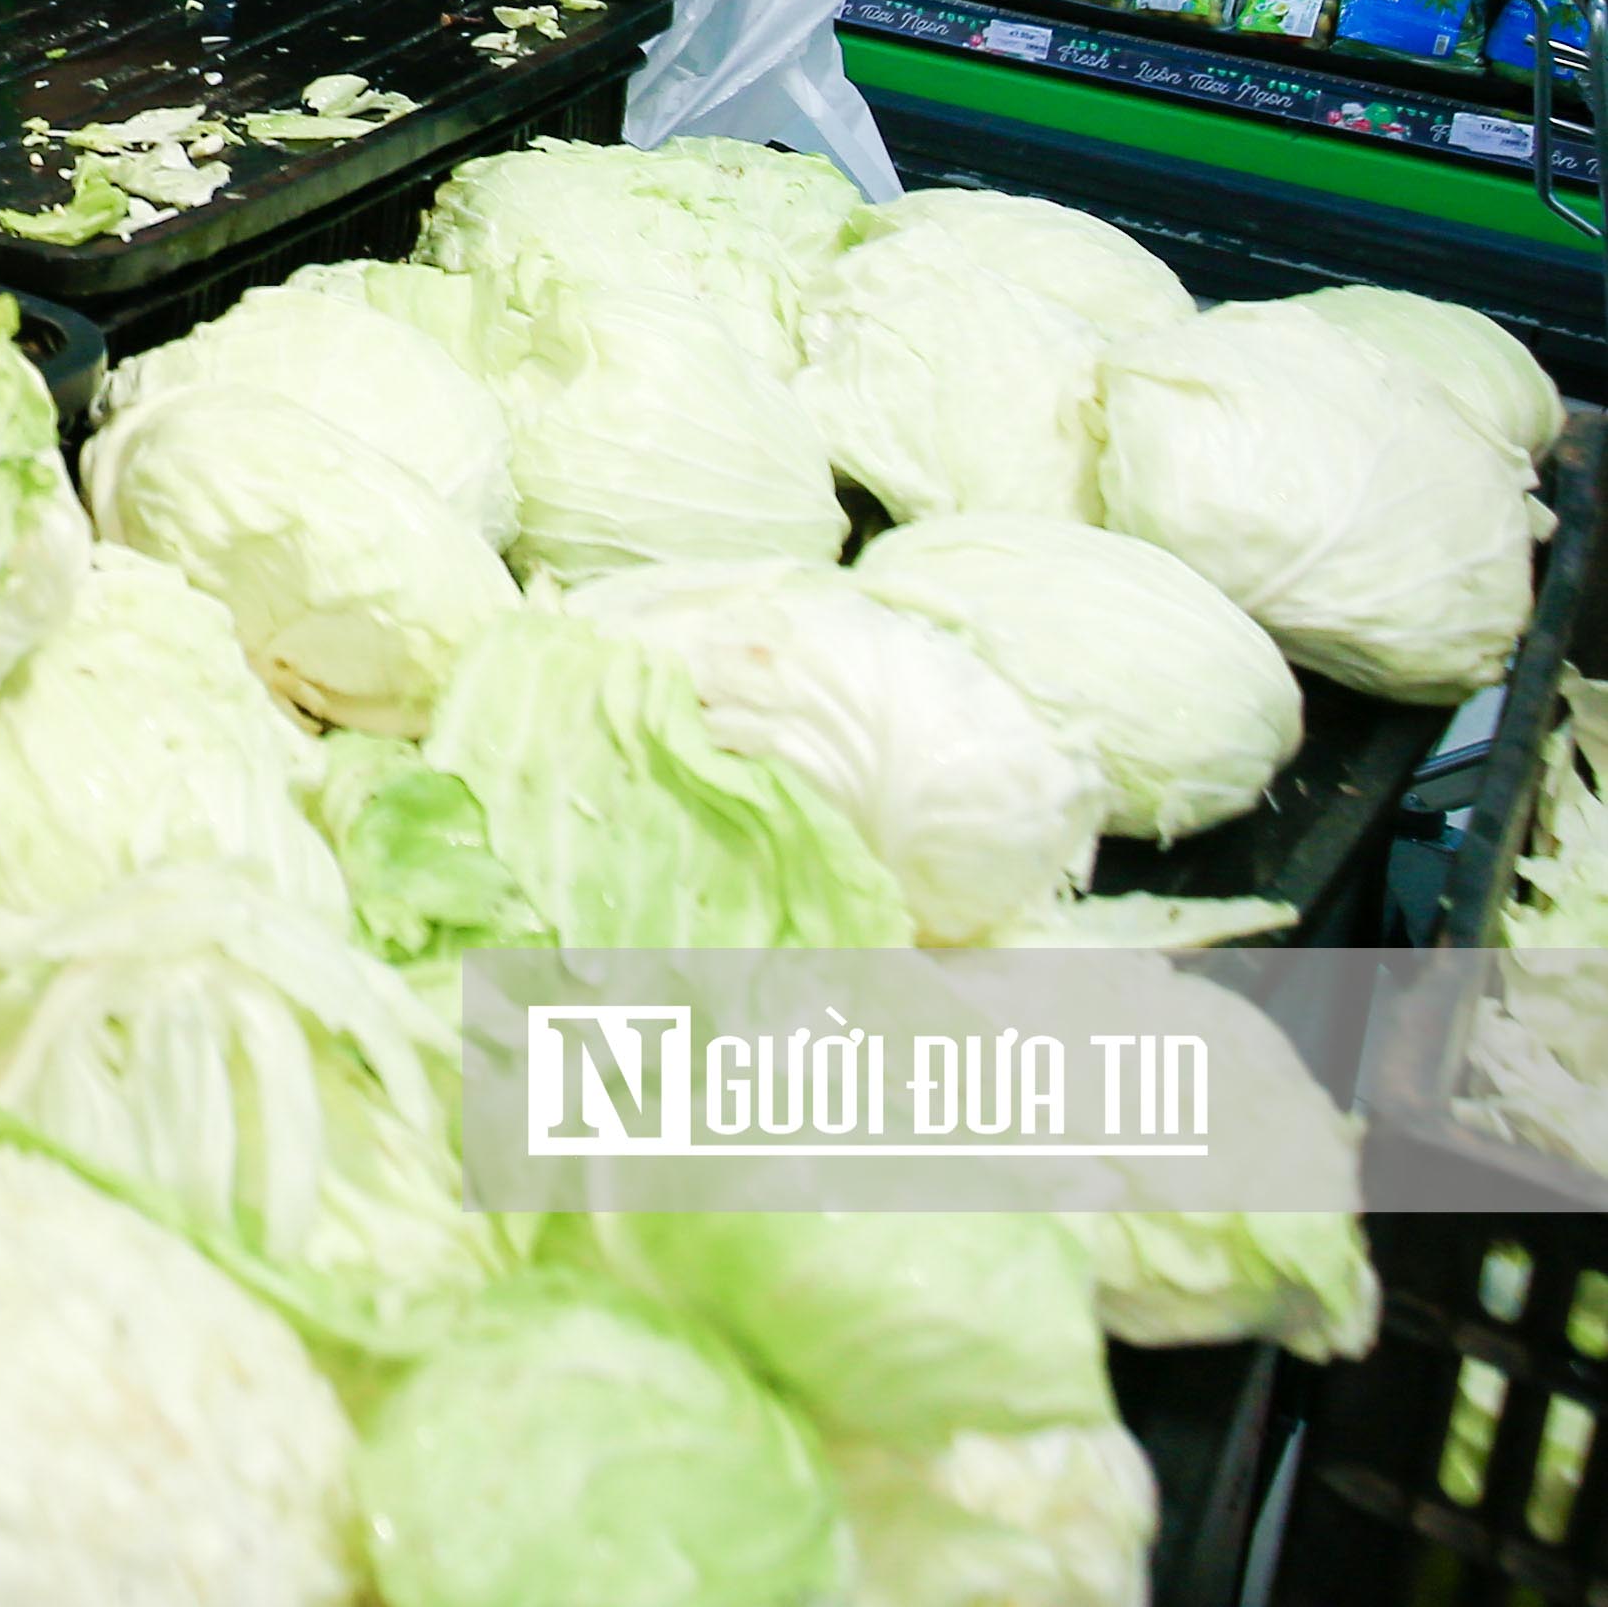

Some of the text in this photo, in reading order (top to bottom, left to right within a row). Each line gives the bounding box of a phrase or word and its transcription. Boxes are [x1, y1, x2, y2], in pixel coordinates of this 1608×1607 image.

[899, 10, 950, 37] Ngon
[1056, 42, 1110, 71] Fresh
[1133, 59, 1183, 84] Luôn
[1233, 81, 1294, 109] Ngon
